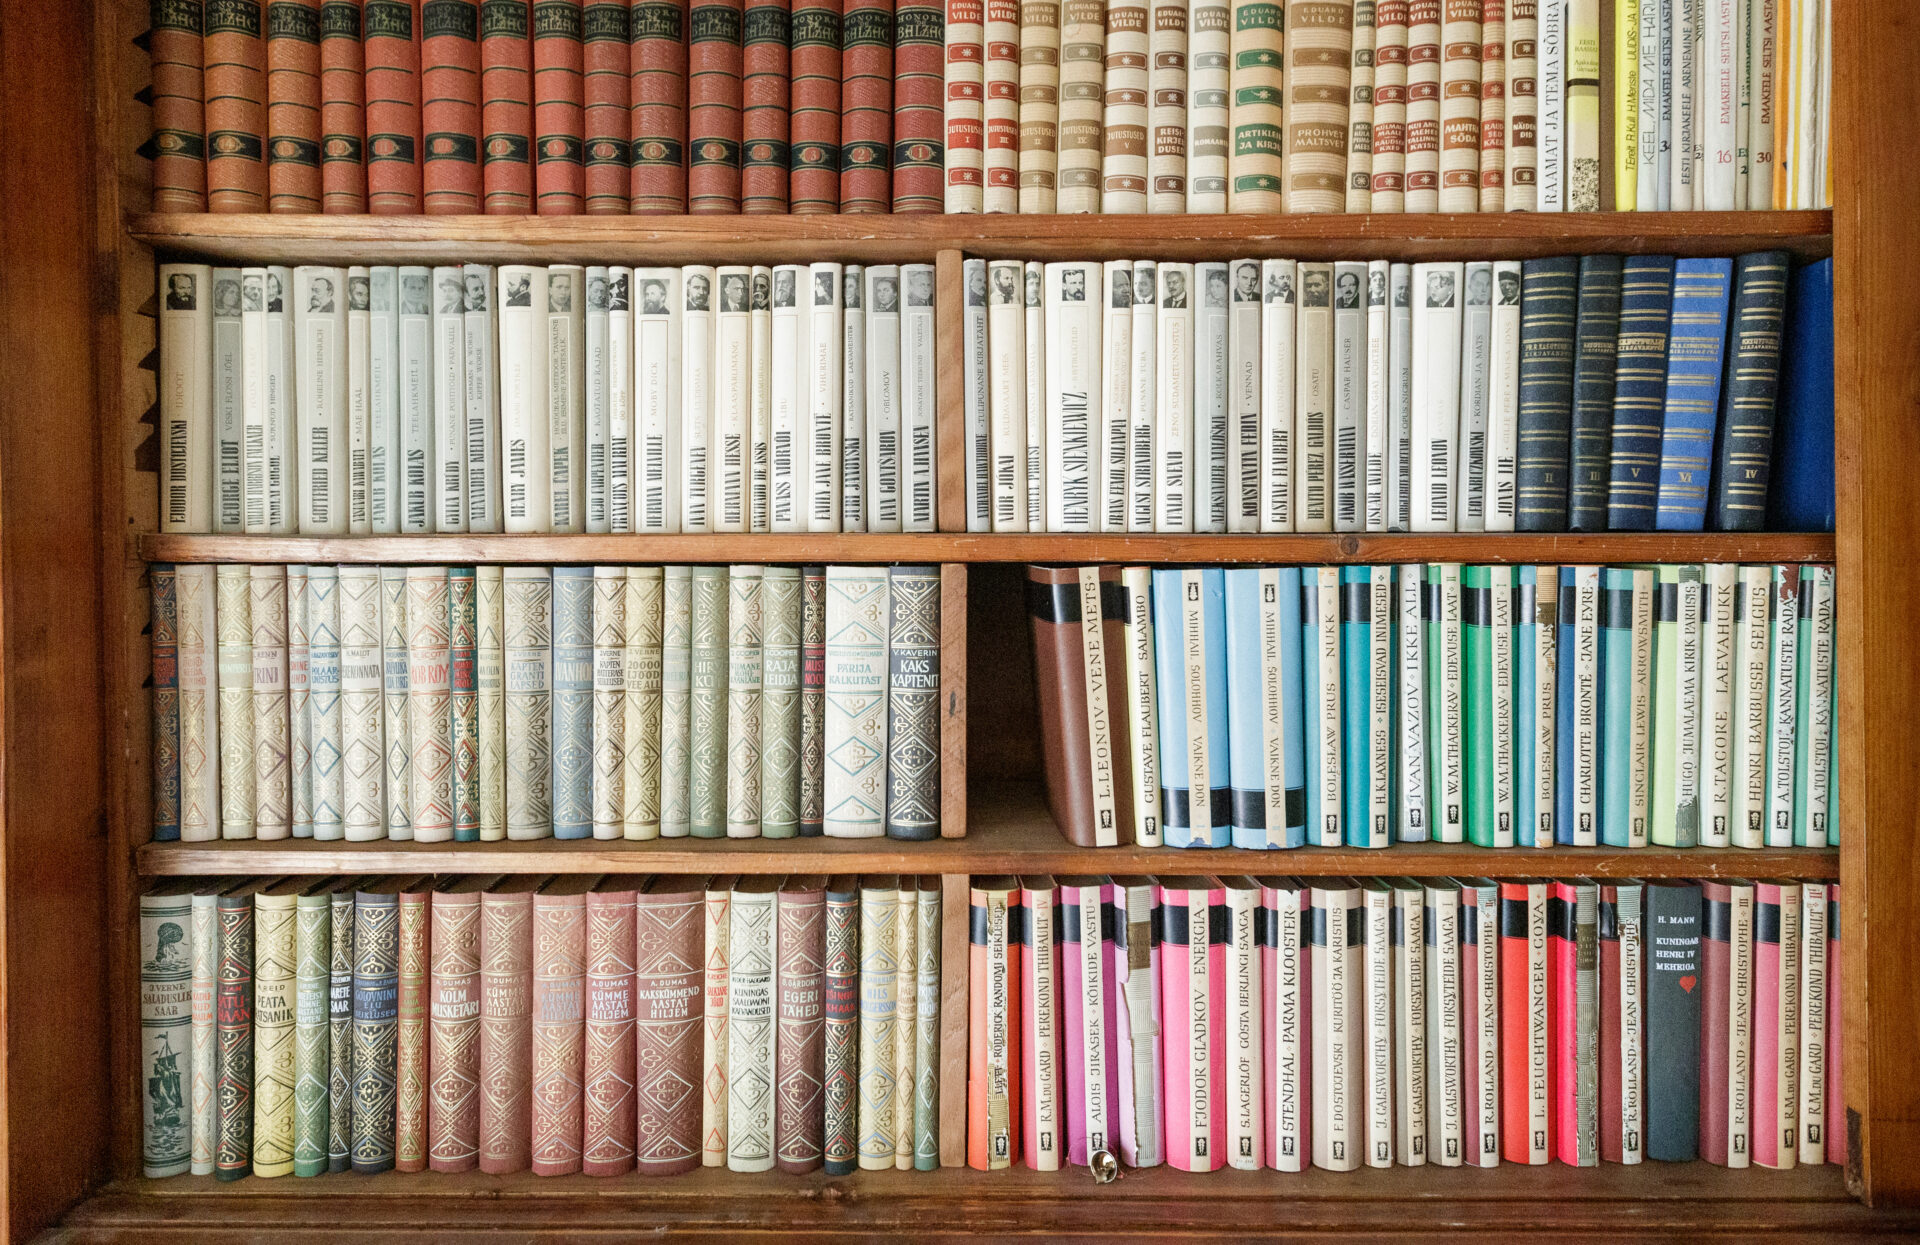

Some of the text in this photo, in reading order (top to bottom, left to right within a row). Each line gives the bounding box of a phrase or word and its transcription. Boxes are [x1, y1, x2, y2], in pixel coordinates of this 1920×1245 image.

[898, 25, 943, 38] BALZAC
[990, 10, 1017, 21] VILDE
[1109, 10, 1144, 19] EDUARD
[1111, 19, 1142, 28] VILDE
[1301, 16, 1345, 24] VILDE
[1643, 46, 1656, 73] ME
[1720, 31, 1730, 125] EMAKEELE SELTSI
[1643, 79, 1655, 119] MIDA
[1761, 37, 1773, 125] EMAKEELE SELTSI
[1681, 27, 1692, 185] EESTI KIRJAKEELE ARENEMINE
[648, 145, 657, 156] 6
[1107, 130, 1144, 140] JUTUSTUSED
[1295, 138, 1344, 147] MALTSVET
[1298, 129, 1344, 138] PROHVET
[1451, 133, 1477, 143] SÕDA
[1545, 60, 1559, 205] RAAMAT JA TEMA
[810, 149, 817, 161] 3
[857, 148, 866, 161] 2
[918, 147, 924, 158] 1
[1717, 150, 1732, 164] 16
[1756, 152, 1772, 163] 30
[647, 362, 663, 527] HERMAN MELVILLE MOBY DICK
[1063, 392, 1088, 524] HENRYK SIENKIEWICZ
[1339, 426, 1355, 489] WASSERMANN
[221, 440, 239, 525] GEORGE ELIOT
[312, 427, 328, 523] GOTTFRIED KELLER
[511, 439, 525, 517] HENRY JAMES
[690, 502, 706, 525] IVAN
[877, 430, 896, 493] GONTŠAROV
[814, 413, 831, 520] EMILY JANE BRONTË
[1135, 425, 1151, 526] AUGUST STRINDBERG
[1306, 412, 1324, 519] BENITO PÉREZ GALDÓS
[1431, 438, 1447, 521] LEONID LEONOV
[1631, 468, 1640, 478] V
[1745, 469, 1758, 479] IV
[407, 449, 425, 527] JAKUB KOLAS
[553, 489, 569, 525] KAREL
[996, 455, 1014, 522] MÓR JÓKAI
[1167, 452, 1183, 526] ITALO SVEVO
[1368, 453, 1381, 525] OSCAR WILDE
[1339, 493, 1355, 523] JAKOB
[1325, 615, 1336, 657] NUKK
[1376, 584, 1387, 714] ISESEISVAD INIMESED
[1446, 593, 1458, 681] EDEVUSE LAAT
[627, 679, 660, 689] VEE ALL
[764, 673, 798, 685] LEIDJA
[829, 675, 882, 685] KALKUTAST
[891, 674, 938, 687] KAPTENIT
[901, 660, 930, 673] KAKS
[1084, 583, 1111, 799] L.LEONOV VENE METS
[1136, 595, 1154, 803] GUSTAVE FLAUBERT SALAMBO
[1188, 611, 1205, 807] MIHHAIL SOLOHHOV VAIKNE DON
[1325, 683, 1336, 720] PRUS
[1405, 583, 1420, 799] IVAN VAZOV IKKE ALL
[1578, 587, 1593, 804] CHARLOTTE BRONTË JANE EYRE
[1635, 591, 1649, 807] SINCLAIR LEWIS ARROWSMITH
[1714, 586, 1730, 803] R.TAGORE LAEVAHUKK
[1749, 588, 1765, 801] HENRI BARBUSSE SELGUS
[1670, 916, 1695, 924] MANN
[1331, 907, 1343, 1033] KURITÖÖ JA KARISTUS
[1656, 950, 1695, 958] HENRI IV
[640, 986, 700, 999] KAKSKÜMMEND
[1238, 910, 1249, 1049] GÖSTA BERLINGI SAAGA
[1784, 913, 1797, 1034] PEREKOND THIBAULT
[154, 1006, 178, 1016] SAAR
[432, 1002, 479, 1018] MUSKETÄRI
[440, 990, 467, 1002] KOLM
[592, 989, 628, 1000] KÜMME
[592, 1000, 628, 1010] AASTAT
[651, 997, 689, 1008] AASTAT
[651, 1008, 688, 1019] HILJEM
[782, 1003, 819, 1016] TÄHED
[784, 990, 819, 1003] EGERI
[993, 963, 1003, 1058] RODERICK RANDOMI
[1533, 902, 1545, 1100] FEUCHTWANGER GOYA
[592, 1009, 629, 1019] HILJEM
[1085, 905, 1102, 1123] ALOIS JIRÁSEK KÕIKIDE VASTU
[1193, 908, 1207, 1128] FJODOR GLADKOV ENERGIA
[1282, 909, 1296, 1131] STENDHAL PARMA KLOOSTER
